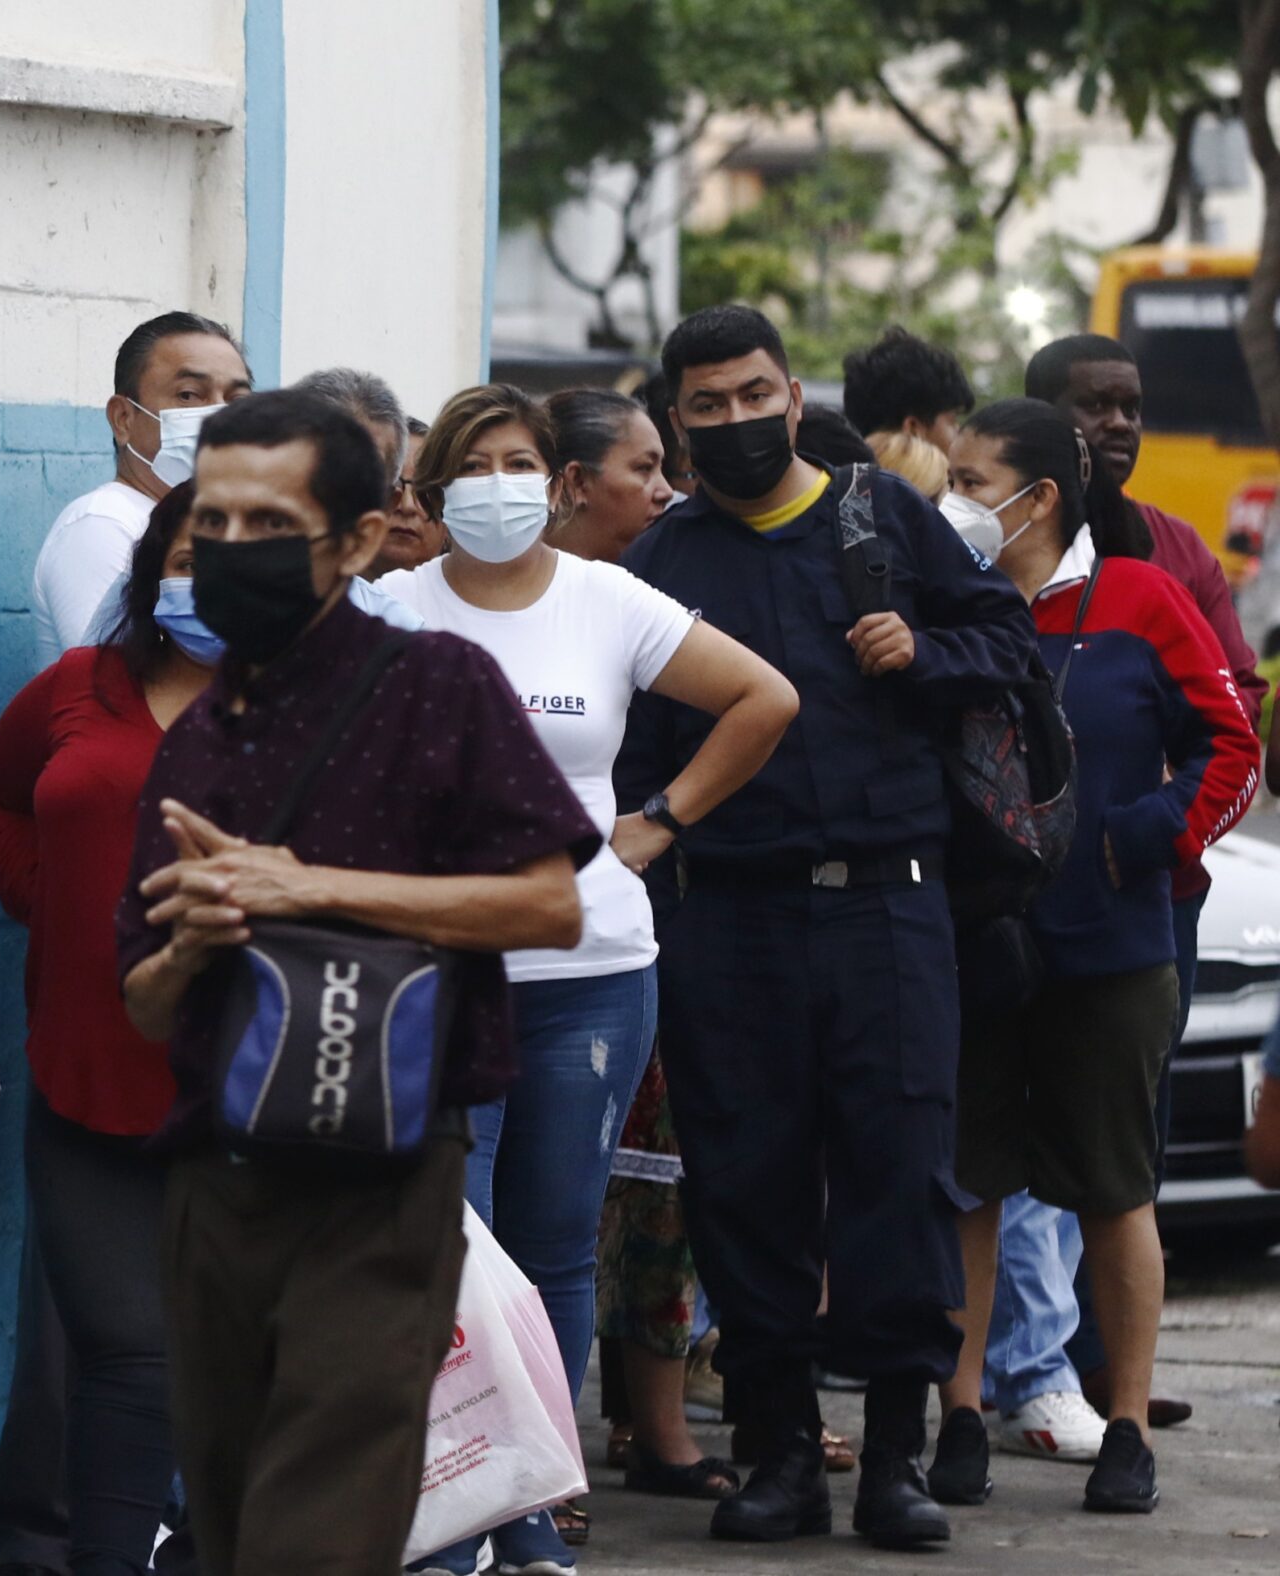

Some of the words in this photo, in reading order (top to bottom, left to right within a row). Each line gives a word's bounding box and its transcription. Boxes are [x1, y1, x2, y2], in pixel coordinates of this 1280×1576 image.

[452, 1386, 498, 1414] RECICLADO
[434, 1450, 456, 1465] funda
[431, 1463, 454, 1477] medio
